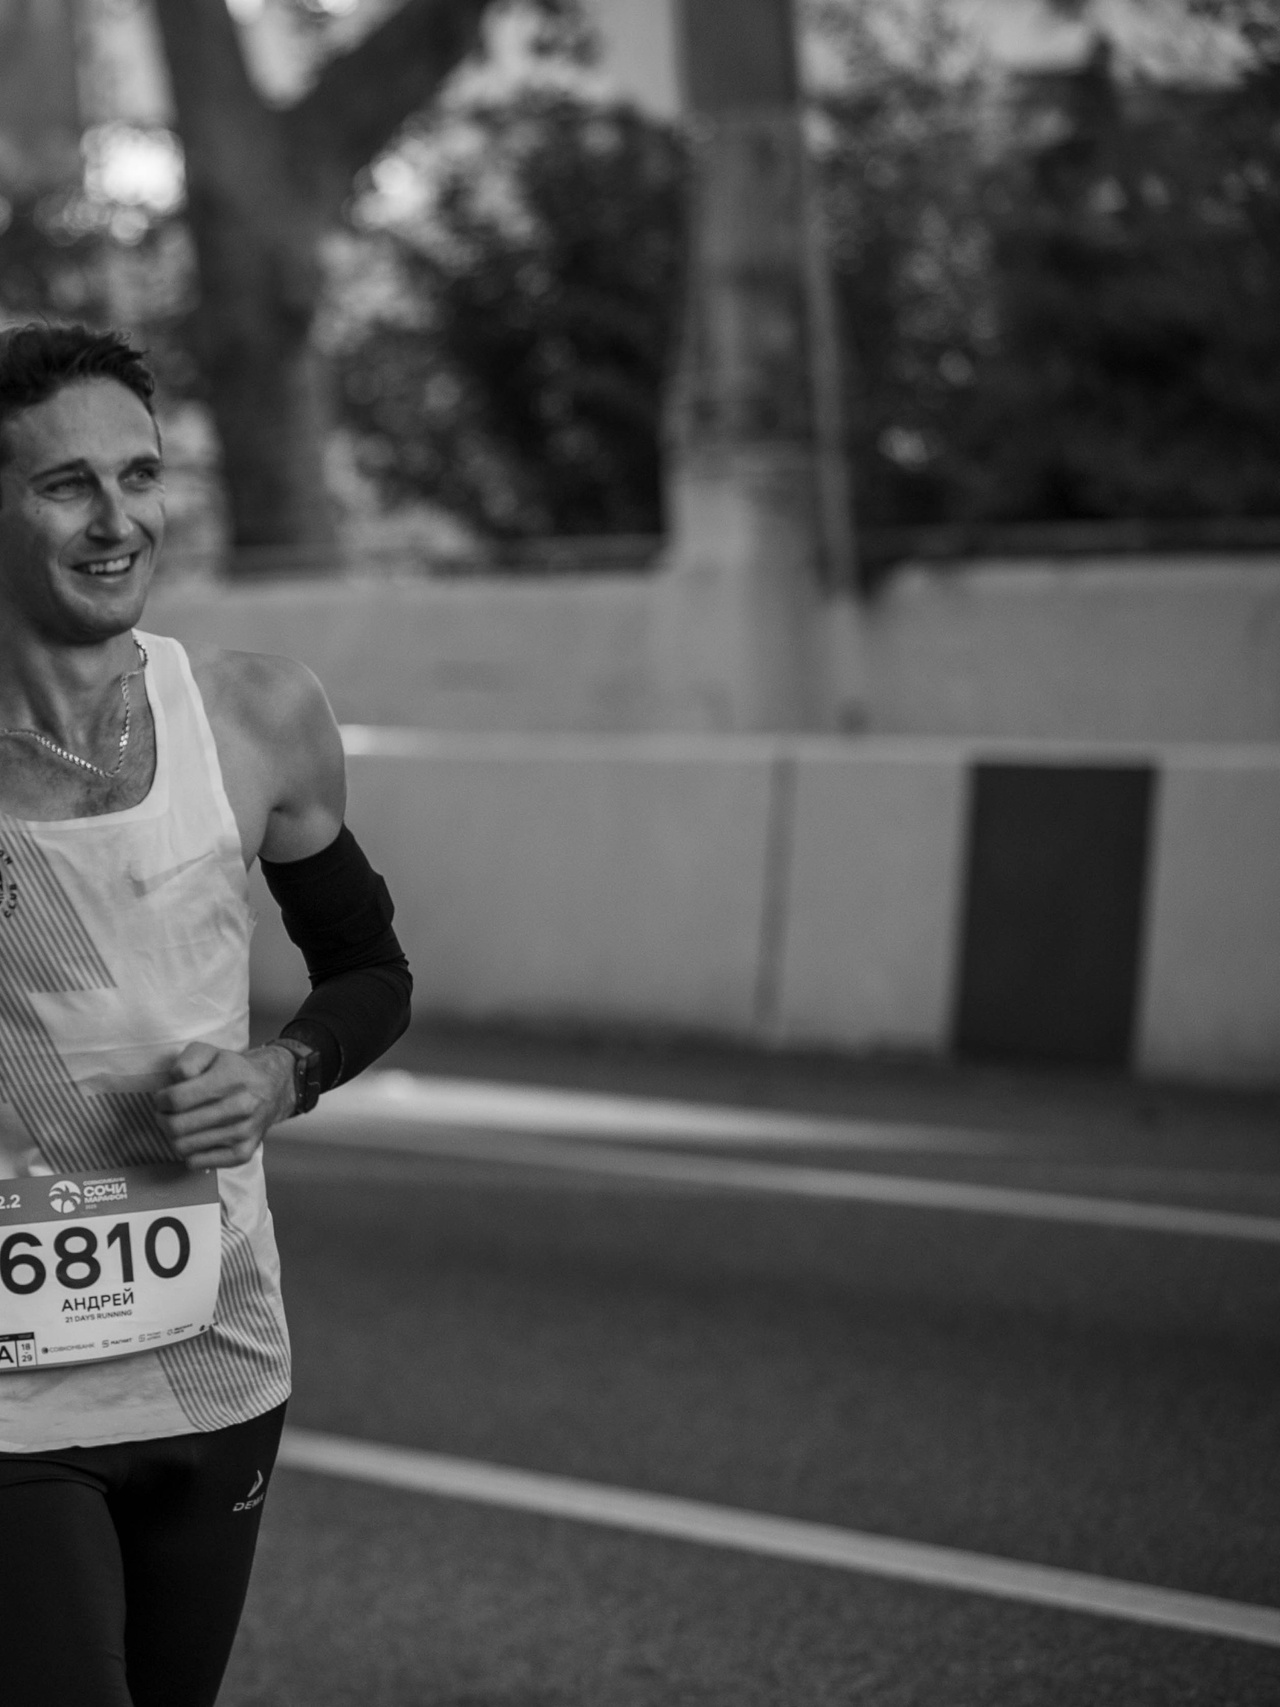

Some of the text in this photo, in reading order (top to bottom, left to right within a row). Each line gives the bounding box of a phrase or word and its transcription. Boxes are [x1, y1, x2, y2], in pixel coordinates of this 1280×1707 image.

[3, 883, 18, 919] CLUB
[83, 1182, 128, 1197] СОЧИ
[84, 1193, 128, 1204] МАРАФОН
[61, 1288, 135, 1312] АНДРЕЙ
[74, 1313, 96, 1322] DAYS
[96, 1309, 133, 1320] RUNNING
[21, 1343, 31, 1351] 18
